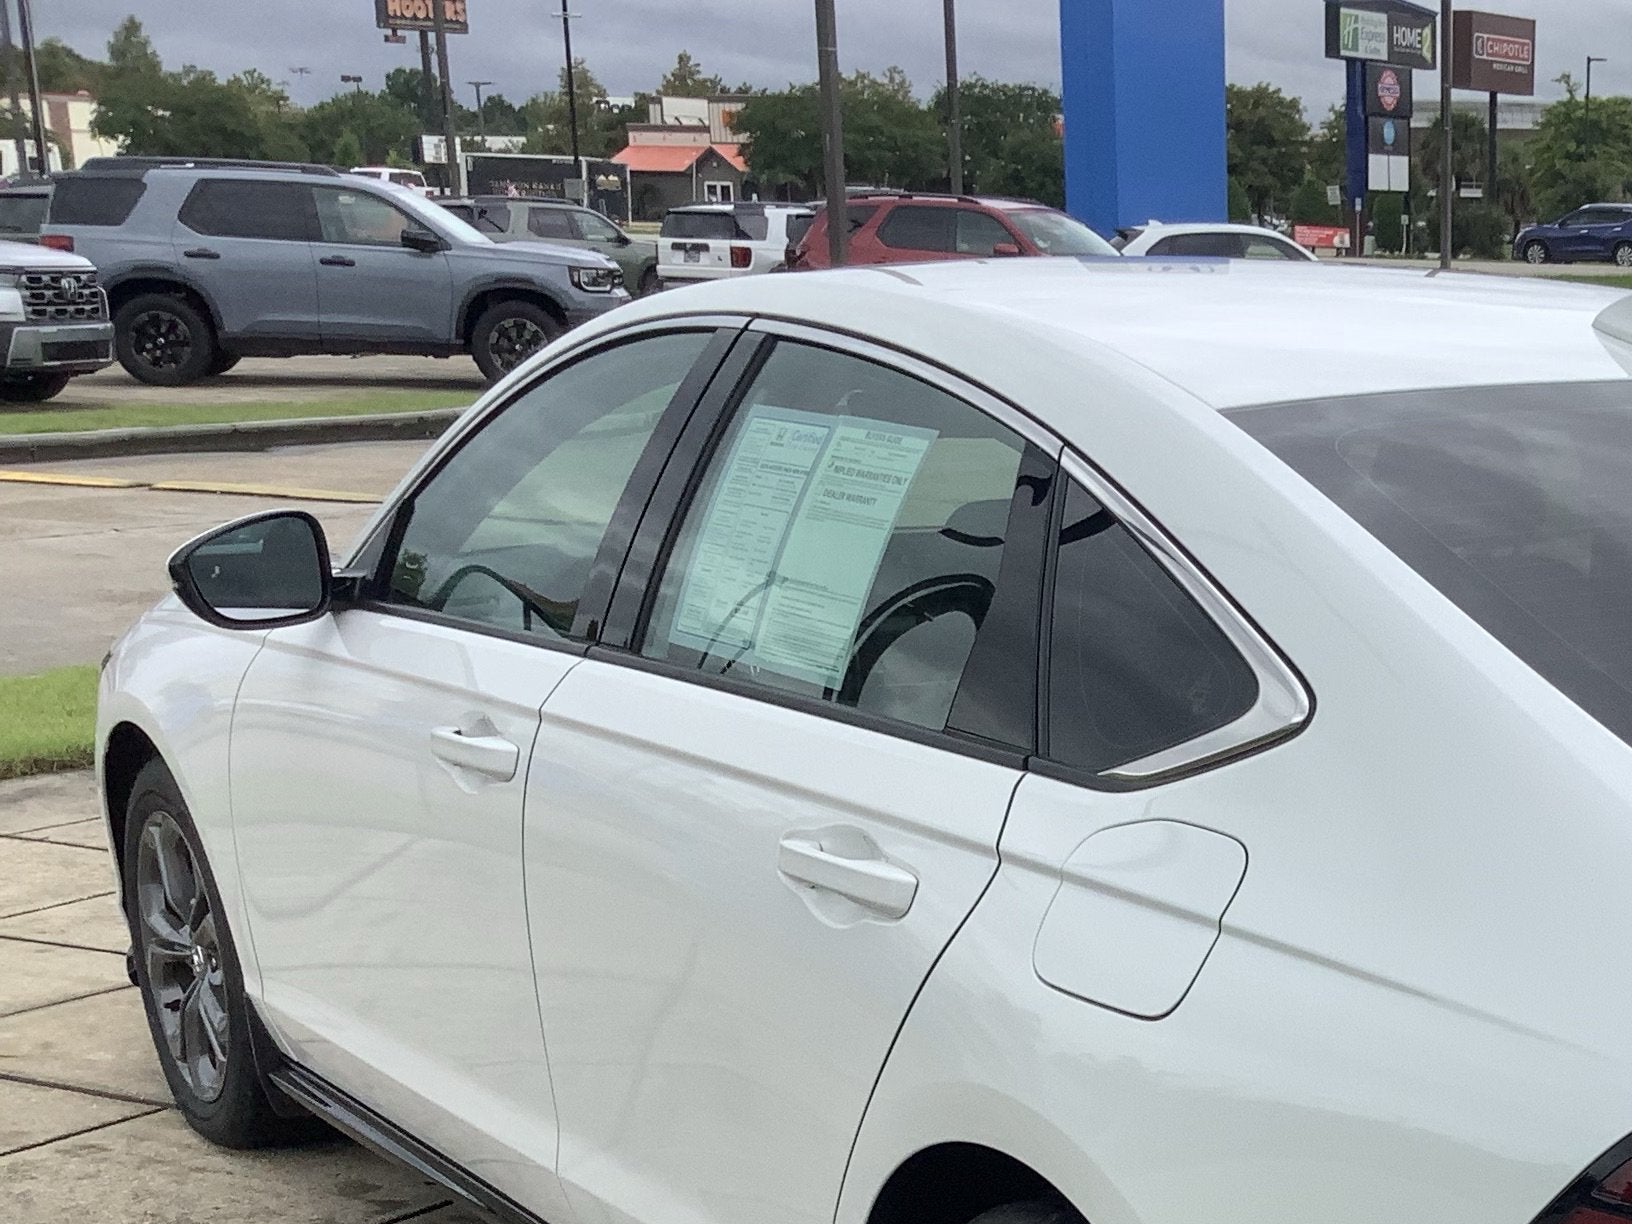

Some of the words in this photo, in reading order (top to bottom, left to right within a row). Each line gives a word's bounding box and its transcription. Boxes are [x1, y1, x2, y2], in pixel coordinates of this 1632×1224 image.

[387, 0, 466, 21] HOOTRS
[1393, 25, 1422, 48] HOME
[1487, 41, 1529, 59] CHIPOTLE
